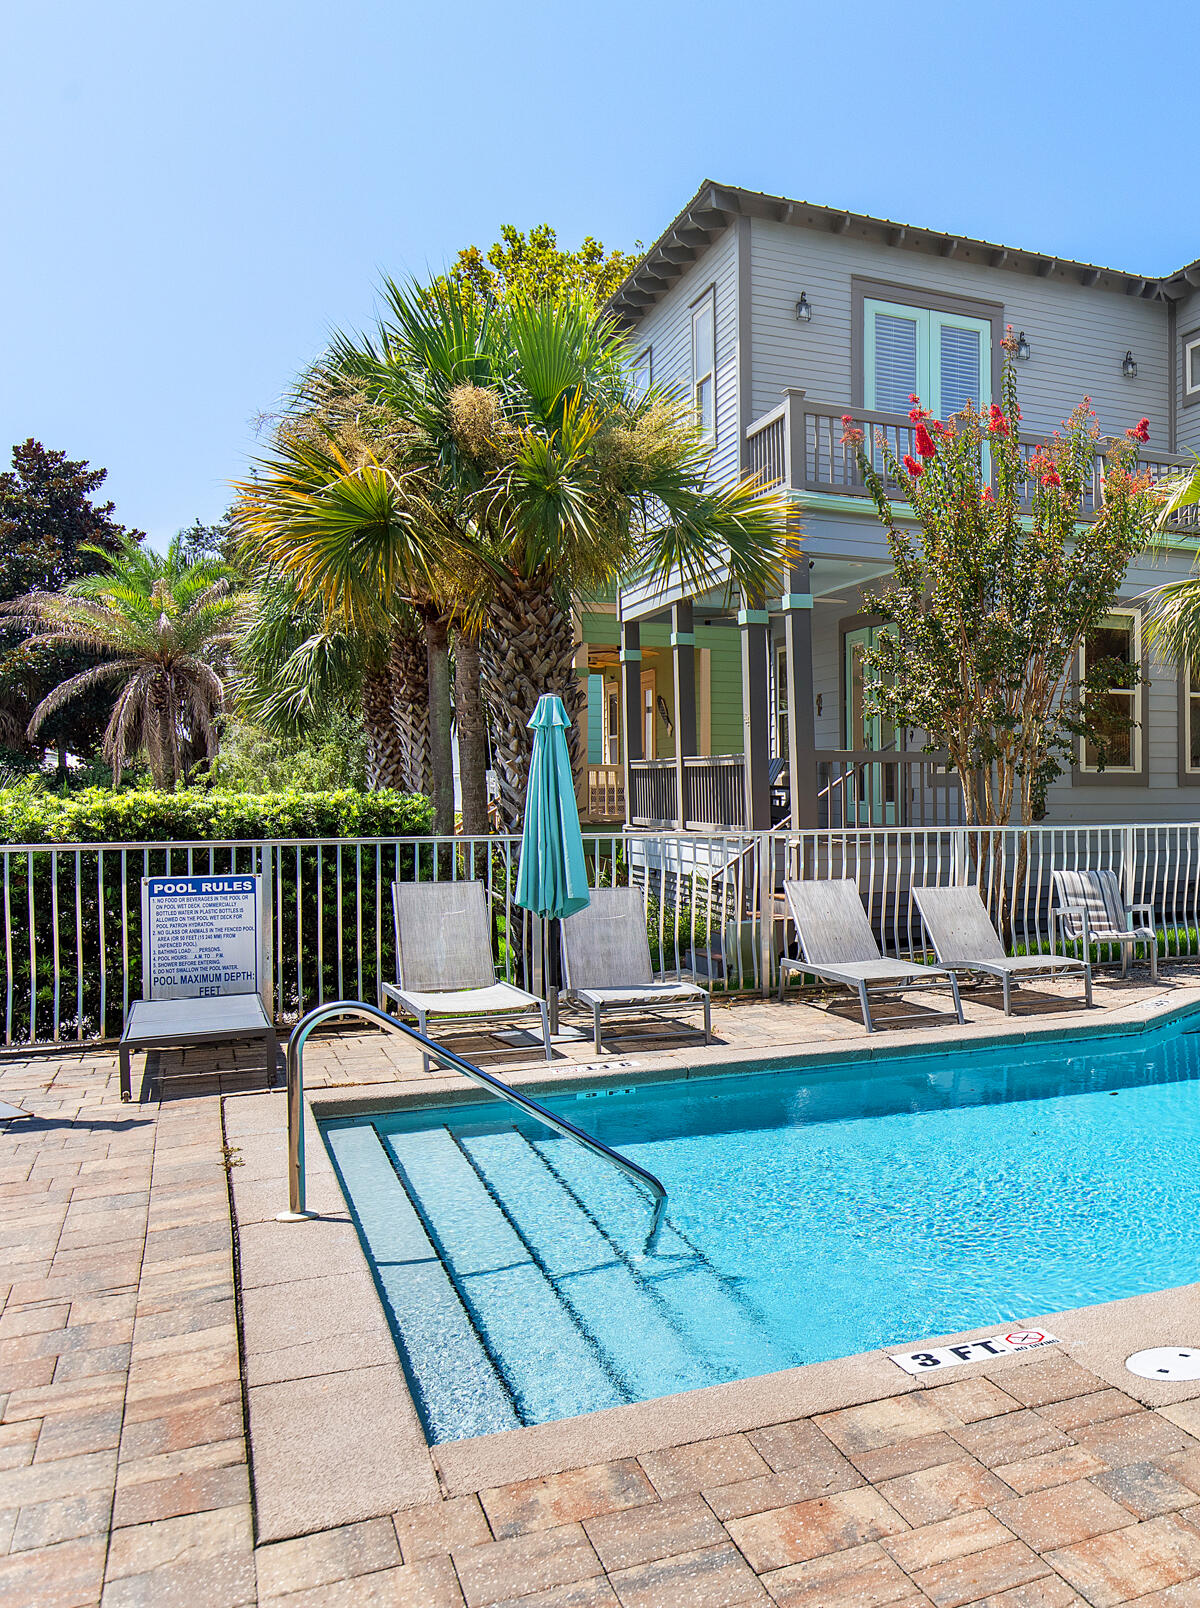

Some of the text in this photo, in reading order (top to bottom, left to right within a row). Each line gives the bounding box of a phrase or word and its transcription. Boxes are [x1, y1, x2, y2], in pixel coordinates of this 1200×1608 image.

[153, 881, 253, 894] POOL RULES
[153, 971, 255, 986] POOL MAXIMUM DEPTH:
[199, 985, 221, 996] FEET
[1029, 1340, 1060, 1349] DIVING
[910, 1340, 1006, 1368] 3 FT.
